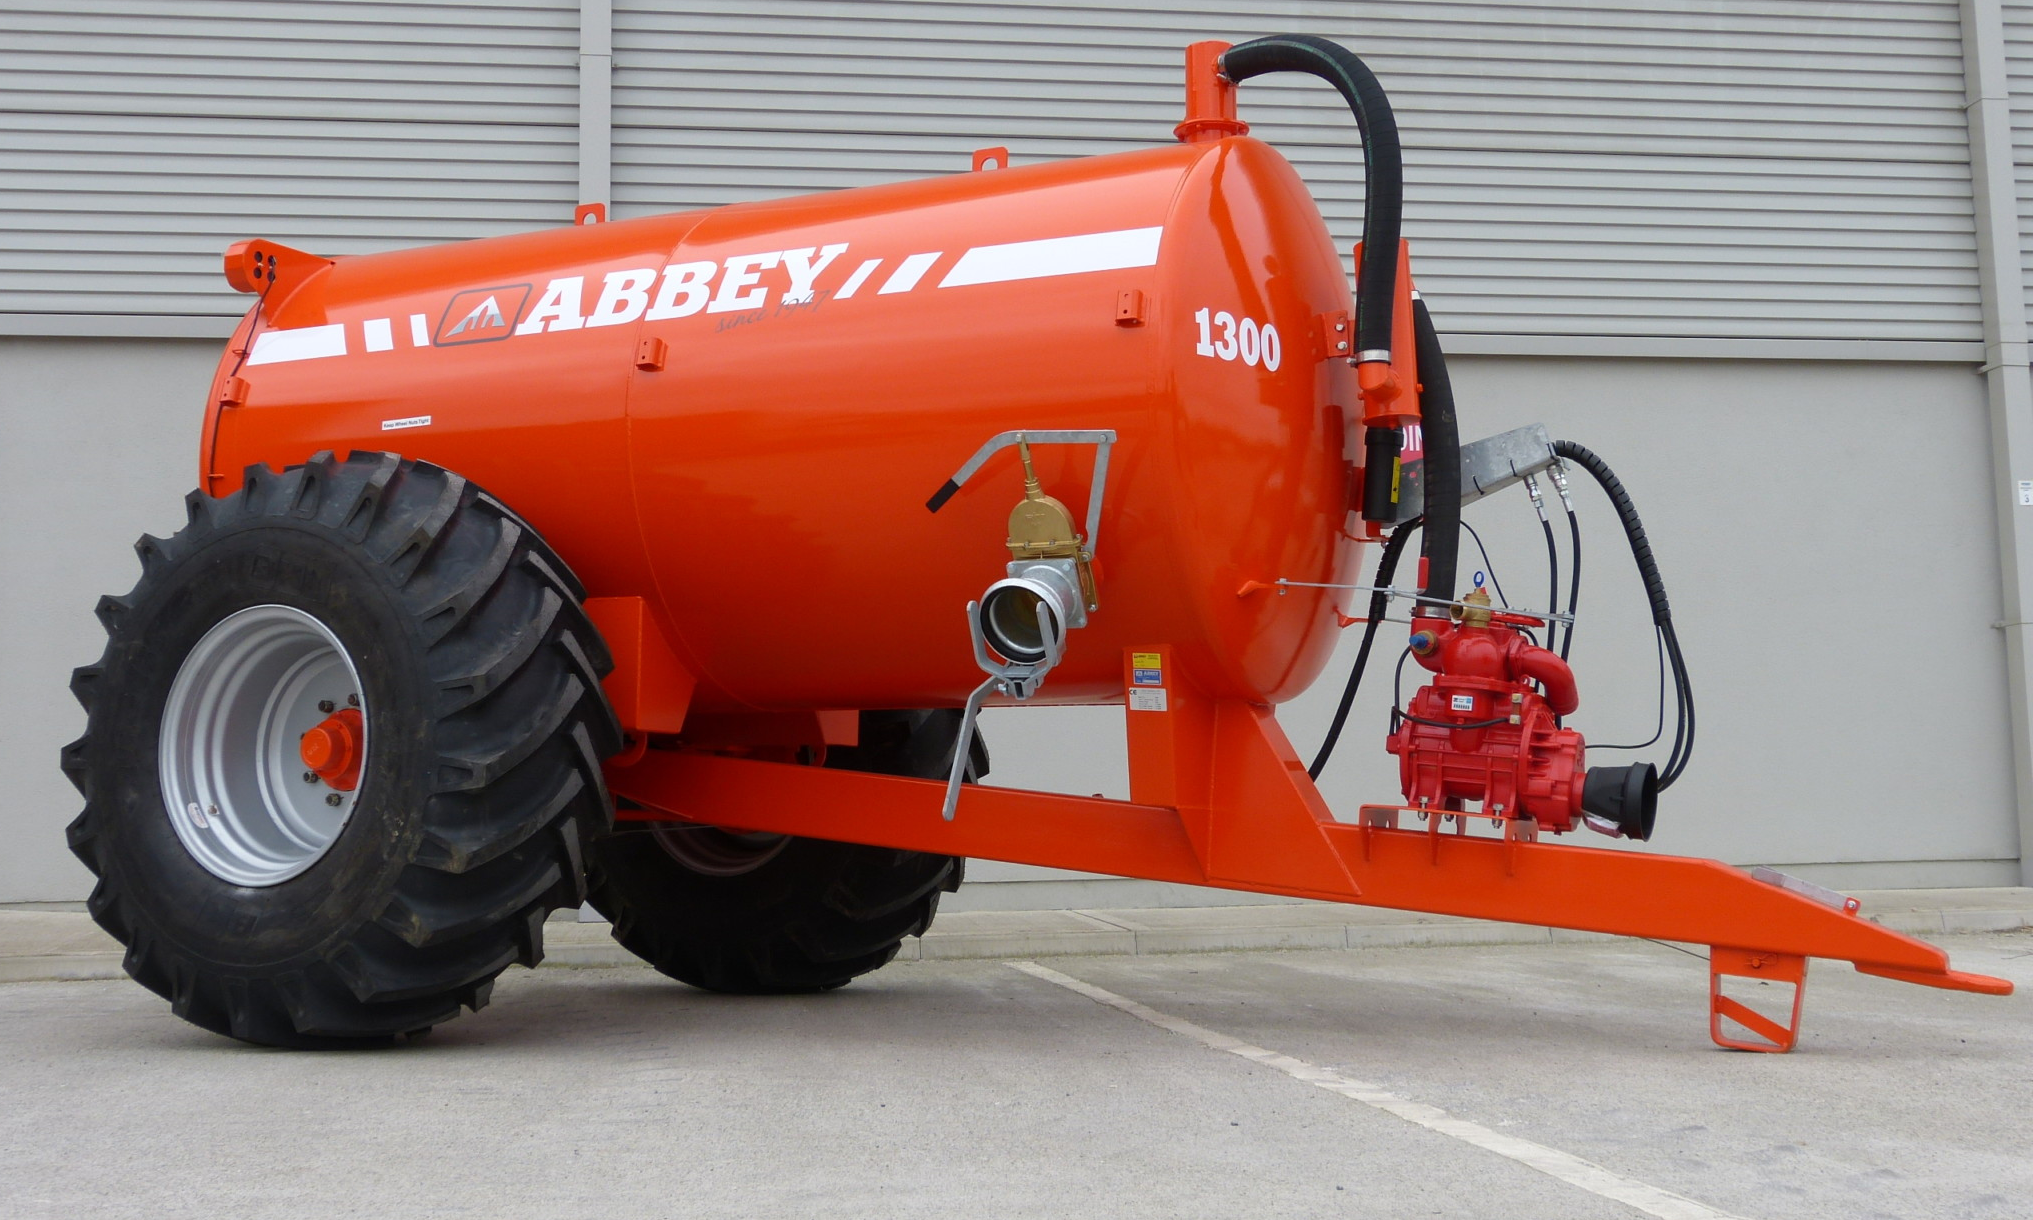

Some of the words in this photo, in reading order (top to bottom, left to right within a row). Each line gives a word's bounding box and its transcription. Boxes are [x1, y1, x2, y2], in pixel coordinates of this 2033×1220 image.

[514, 243, 849, 336] ABBEY
[715, 308, 768, 334] since
[774, 289, 832, 319] 1947
[1194, 307, 1281, 372] 1300
